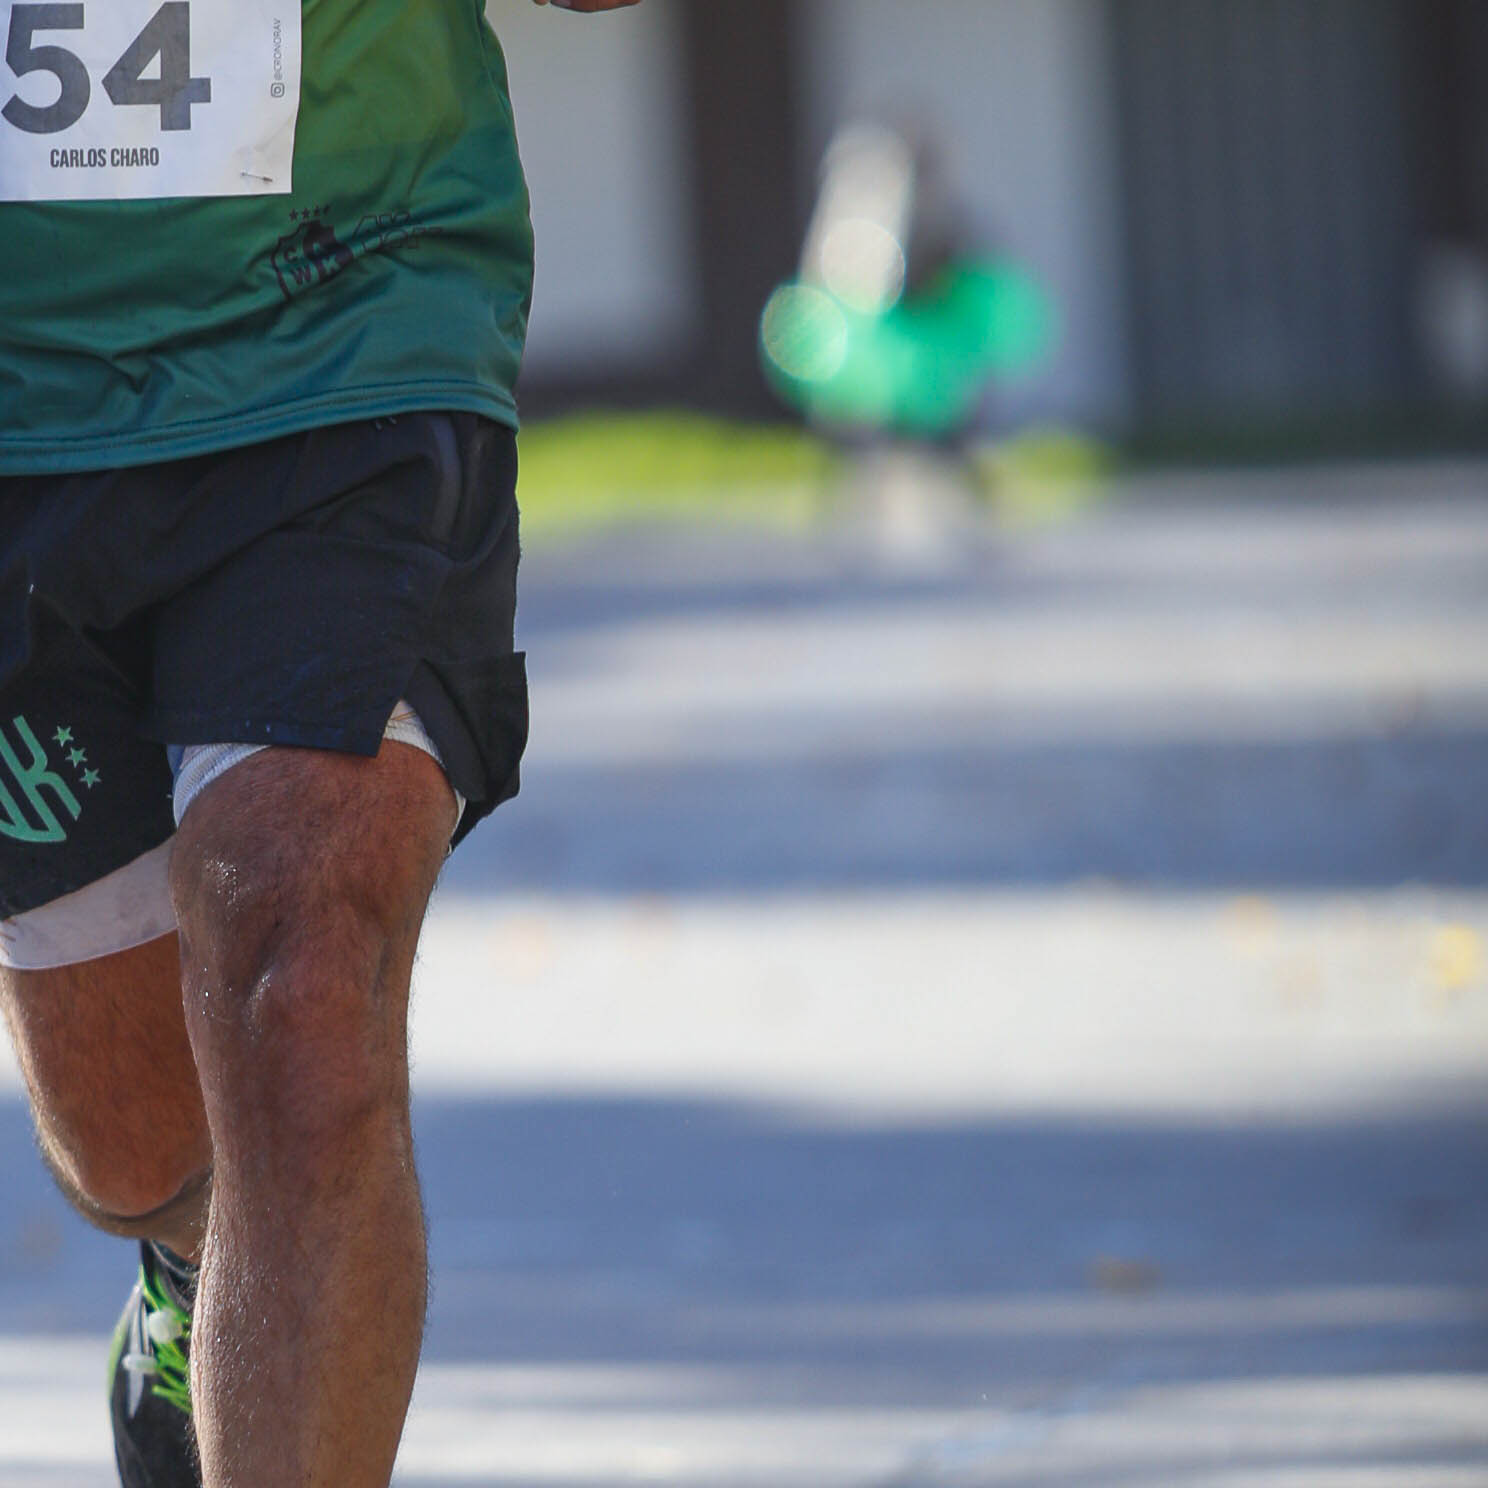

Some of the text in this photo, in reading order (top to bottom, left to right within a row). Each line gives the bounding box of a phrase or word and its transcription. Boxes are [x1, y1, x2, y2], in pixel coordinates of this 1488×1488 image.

[1, 1, 211, 134] 54
[50, 147, 160, 168] CARLOS CHARO
